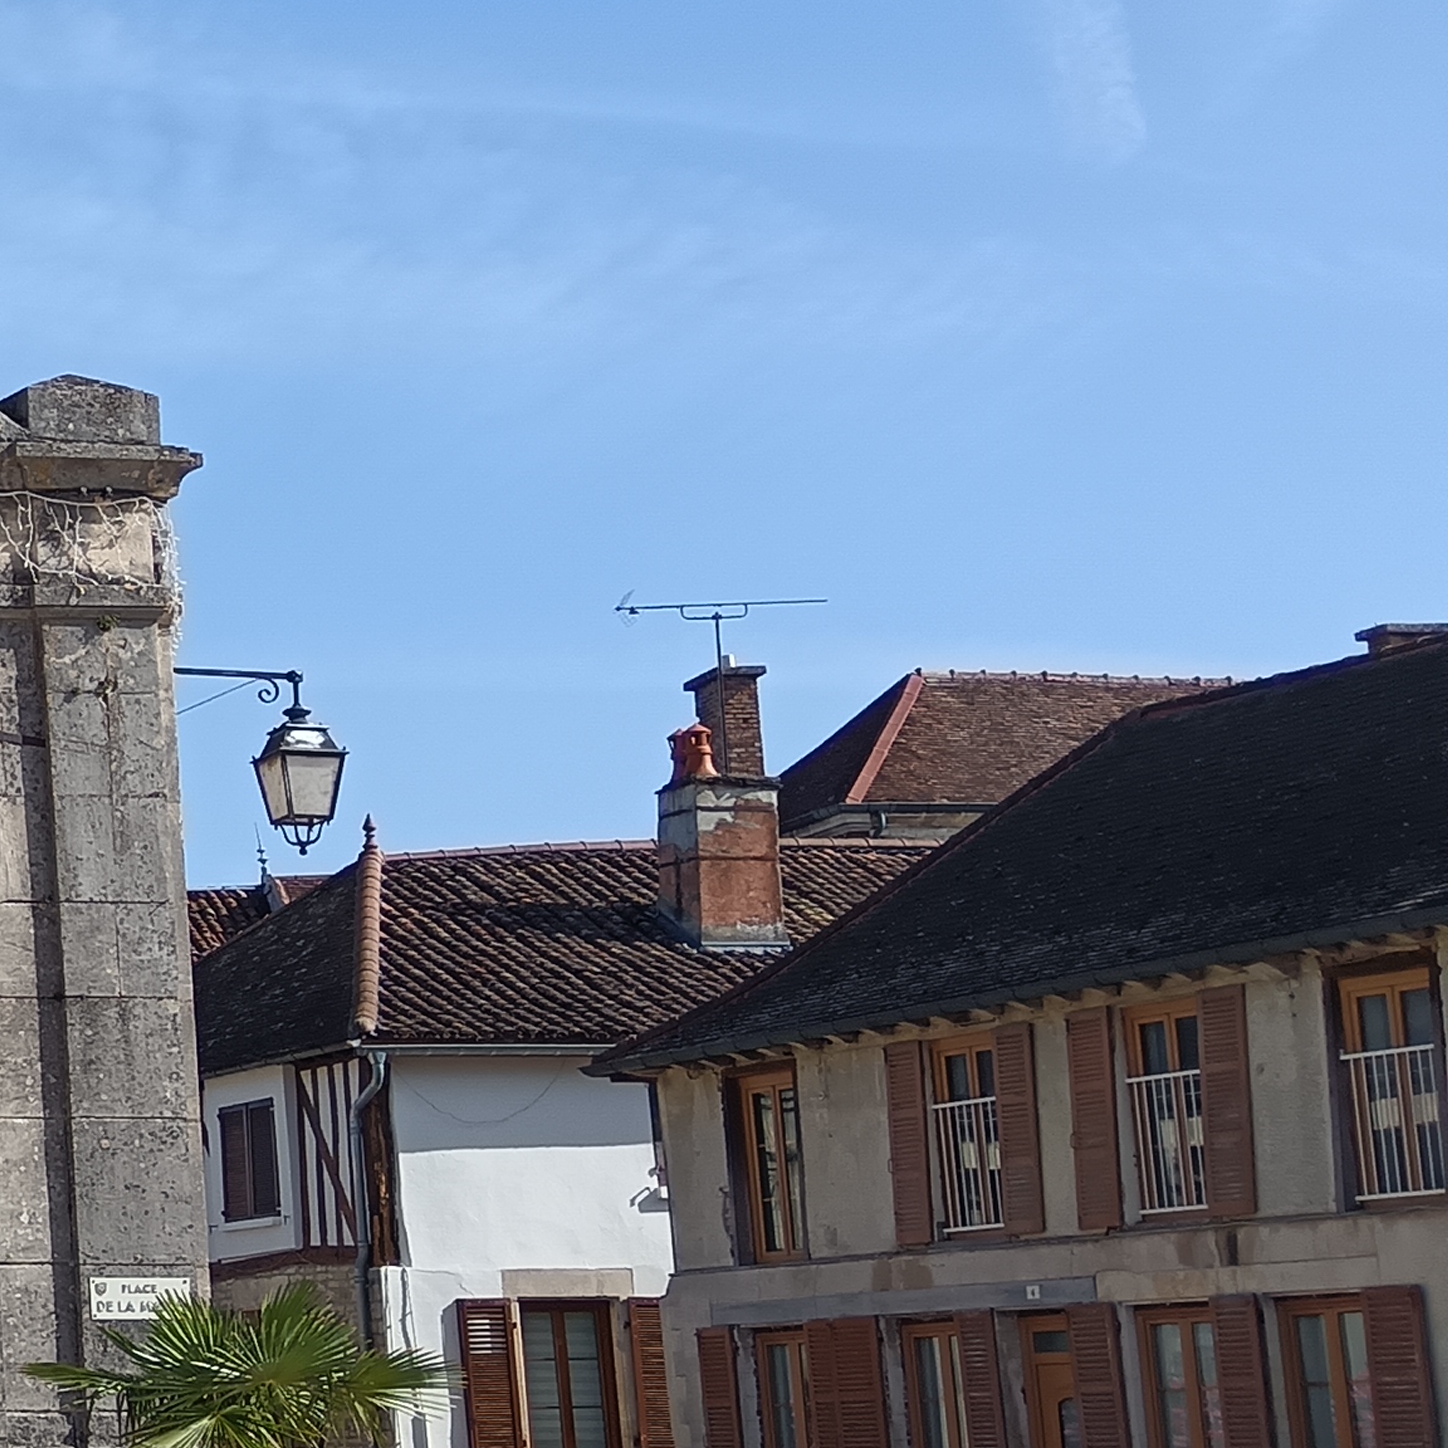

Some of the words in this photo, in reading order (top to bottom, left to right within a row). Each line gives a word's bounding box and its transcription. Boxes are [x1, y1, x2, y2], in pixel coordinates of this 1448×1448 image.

[121, 1284, 158, 1294] PLACE
[96, 1300, 114, 1313] DE
[117, 1300, 135, 1313] LA
